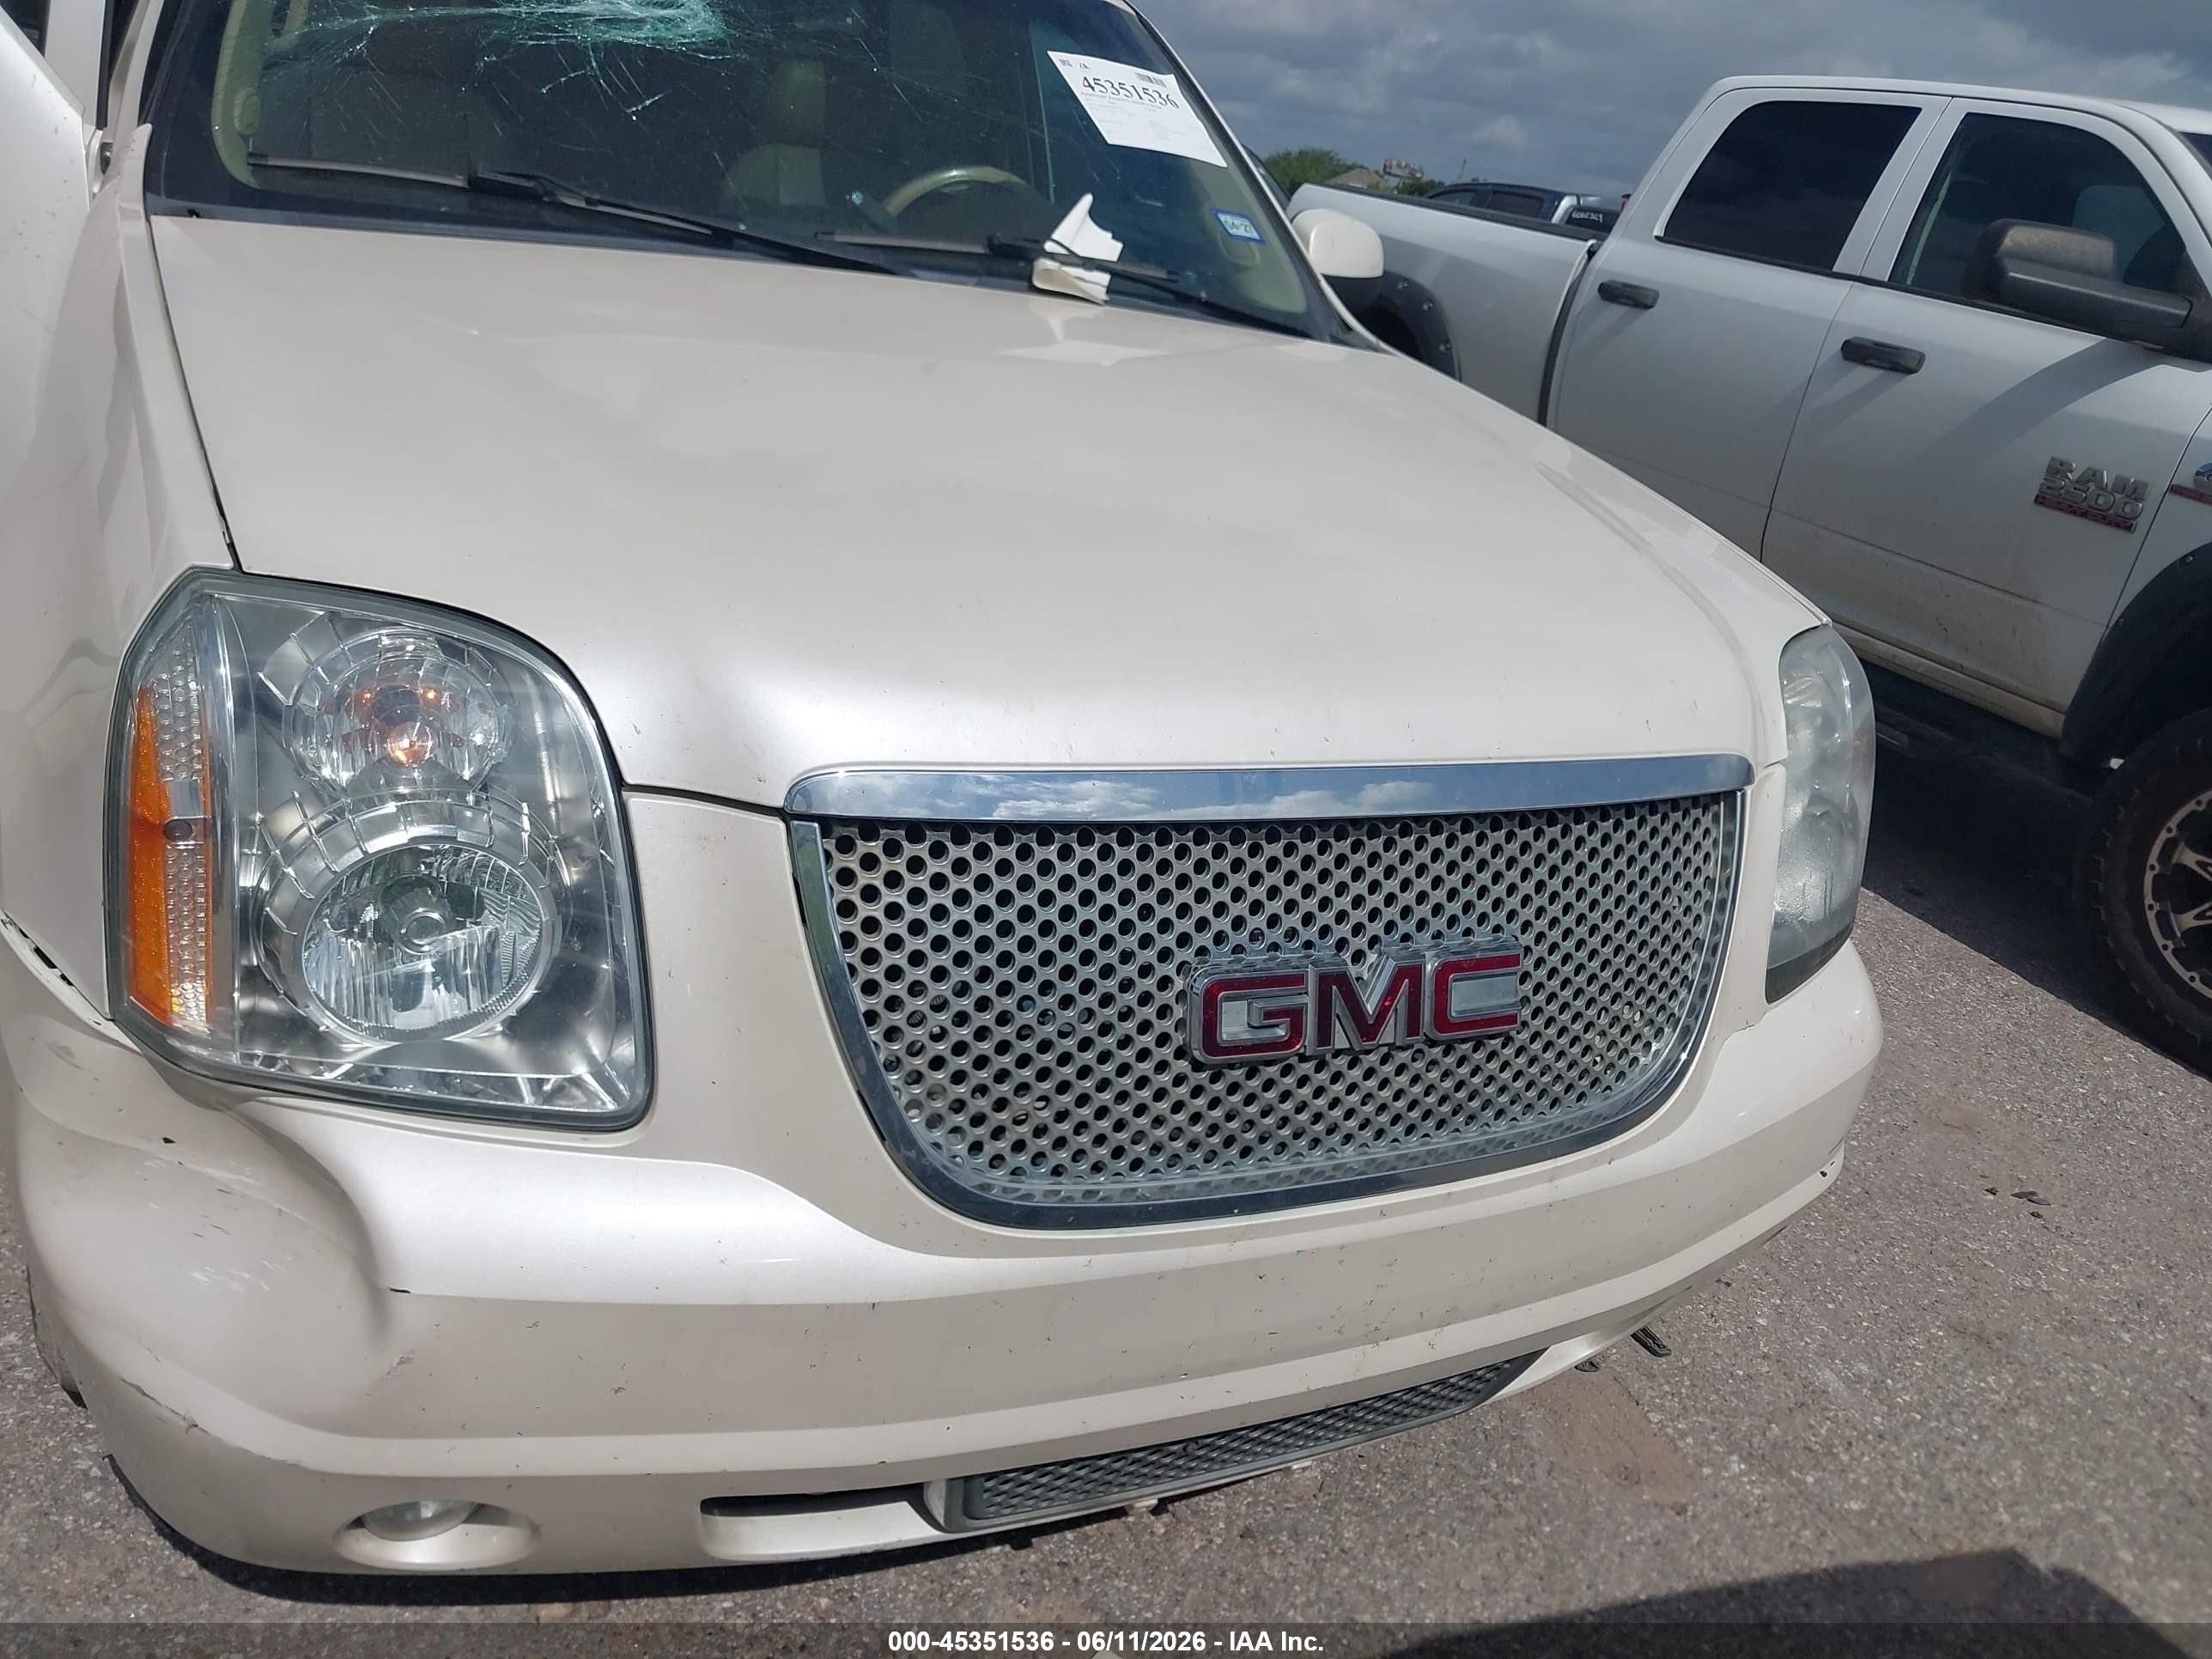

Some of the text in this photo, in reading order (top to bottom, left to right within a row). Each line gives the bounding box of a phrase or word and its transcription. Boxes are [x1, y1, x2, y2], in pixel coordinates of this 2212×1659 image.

[1082, 76, 1180, 109] 45351536
[2038, 475, 2144, 520] 2500
[2045, 456, 2148, 501] RAM
[1188, 937, 1522, 1065] GMC
